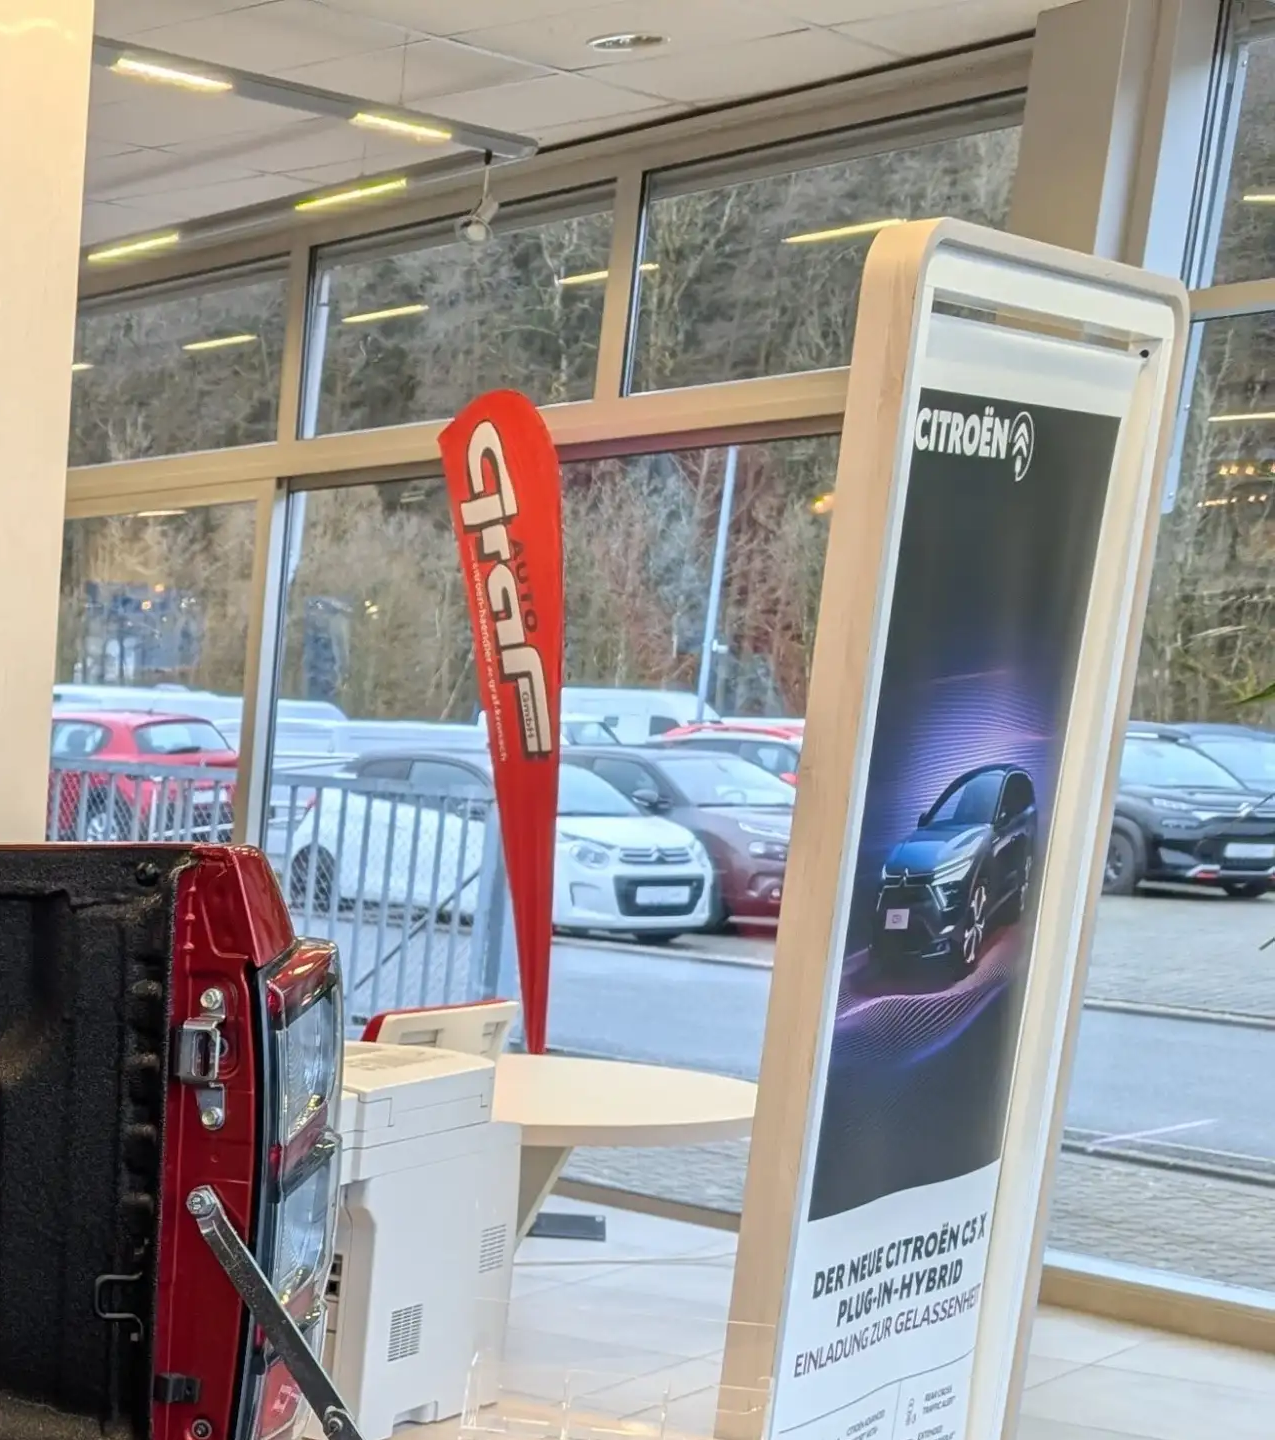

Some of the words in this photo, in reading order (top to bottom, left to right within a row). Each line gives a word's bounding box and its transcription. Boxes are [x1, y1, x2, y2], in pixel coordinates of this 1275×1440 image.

[914, 405, 1010, 459] CITROËN
[509, 537, 538, 632] AUTO
[521, 690, 535, 739] GmbH
[812, 1263, 846, 1299] DER
[847, 1246, 884, 1287] NEUE
[885, 1222, 960, 1269] CITROËN
[961, 1217, 977, 1247] C5
[977, 1211, 987, 1240] X
[836, 1258, 963, 1327] PLUG-IN-HYBRID
[793, 1325, 869, 1378] EINLADUNG
[869, 1316, 893, 1346] ZUR
[894, 1282, 982, 1334] GELASSENHEIT
